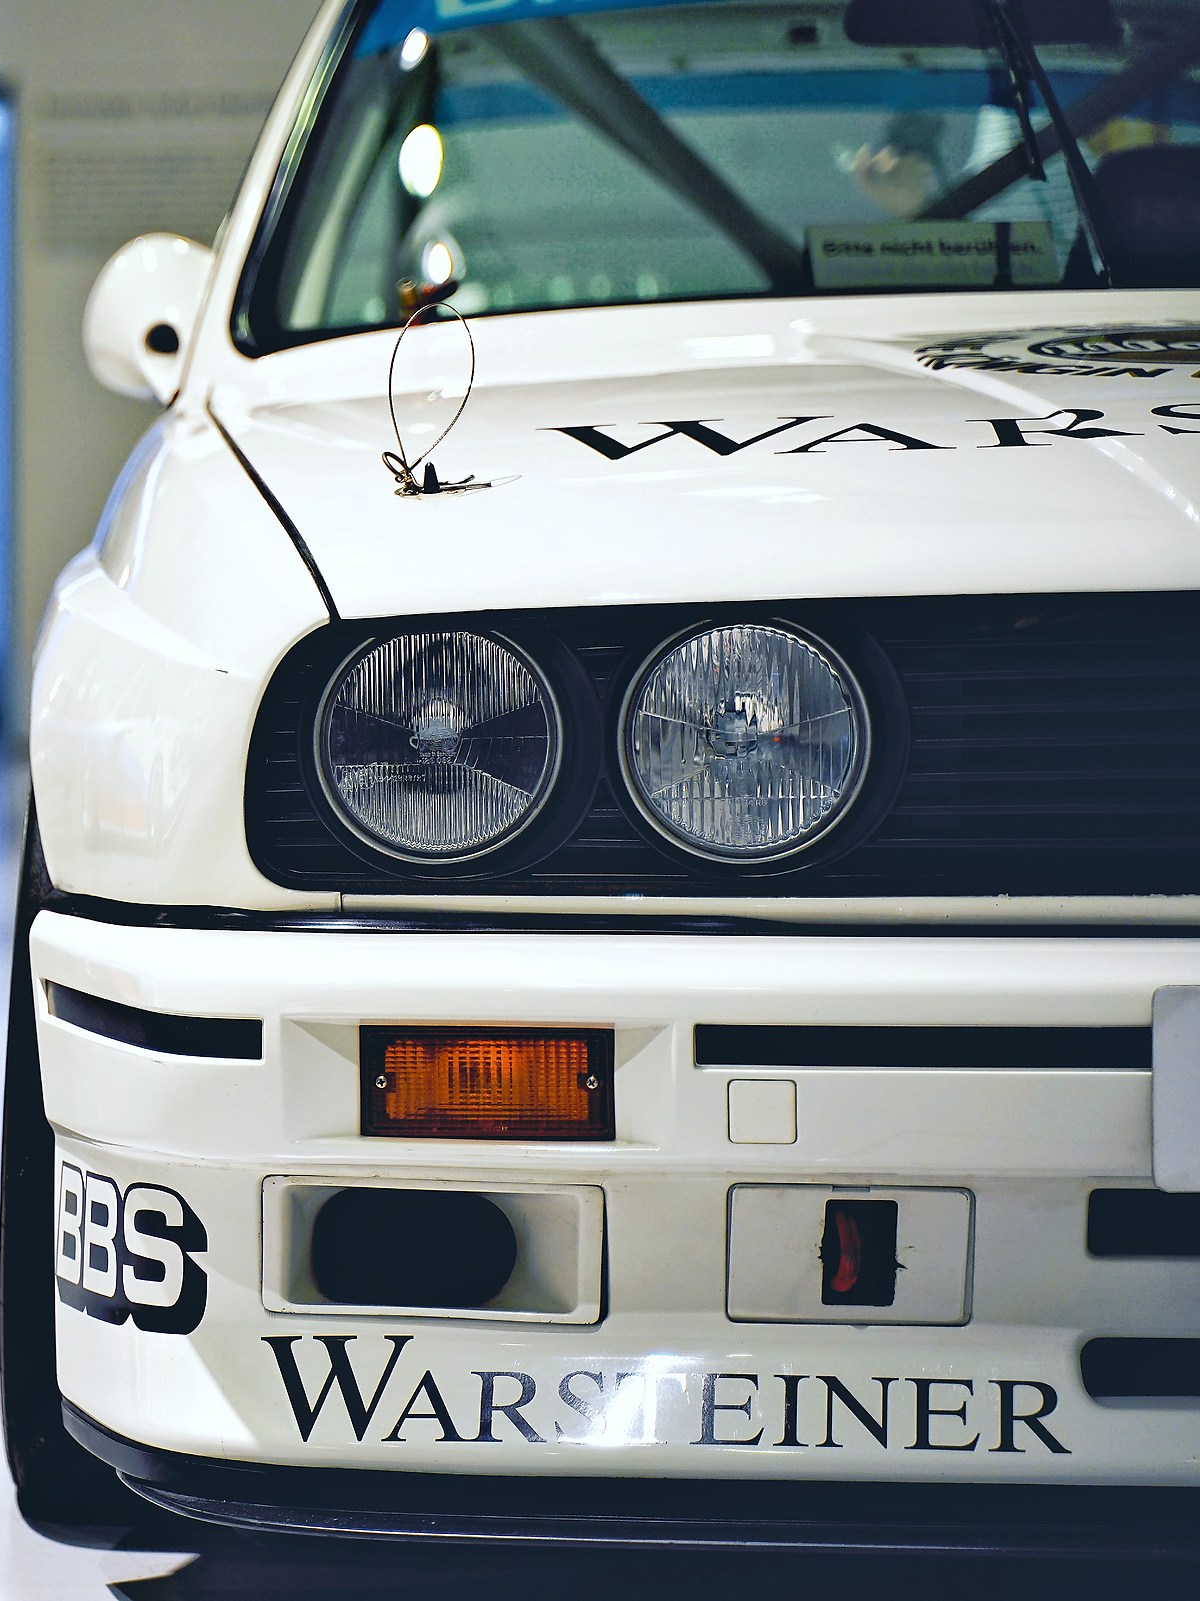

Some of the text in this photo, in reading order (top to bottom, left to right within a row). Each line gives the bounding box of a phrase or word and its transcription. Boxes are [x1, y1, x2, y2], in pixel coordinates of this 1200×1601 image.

[822, 234, 1044, 257] Bitte nicht berühen.
[56, 1161, 208, 1335] BBS
